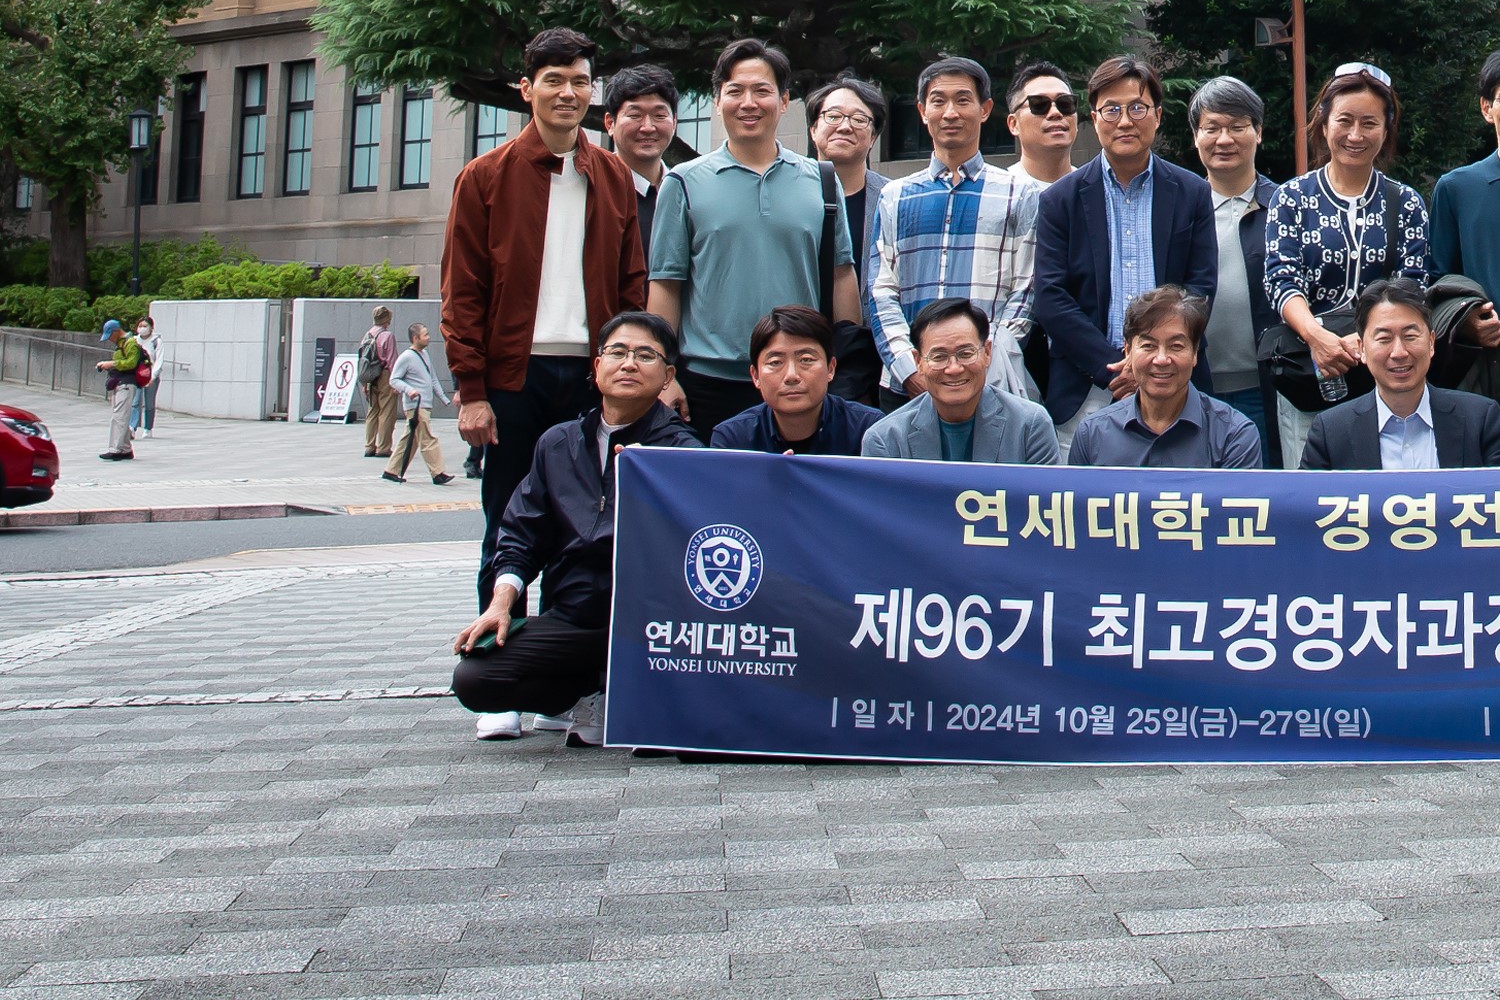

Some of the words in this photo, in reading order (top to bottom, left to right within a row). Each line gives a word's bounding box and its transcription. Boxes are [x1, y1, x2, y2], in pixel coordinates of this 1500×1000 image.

[956, 490, 1275, 550] 연세대학교
[688, 531, 709, 565] YONSEI
[712, 528, 760, 568] UNIVERSITY
[645, 621, 798, 657] 연세대학교
[850, 588, 1053, 666] 제96기
[648, 657, 702, 673] YONSEI
[706, 659, 797, 677] UNIVERSITY
[947, 704, 1041, 734] 2024년
[1055, 706, 1115, 736] 10월
